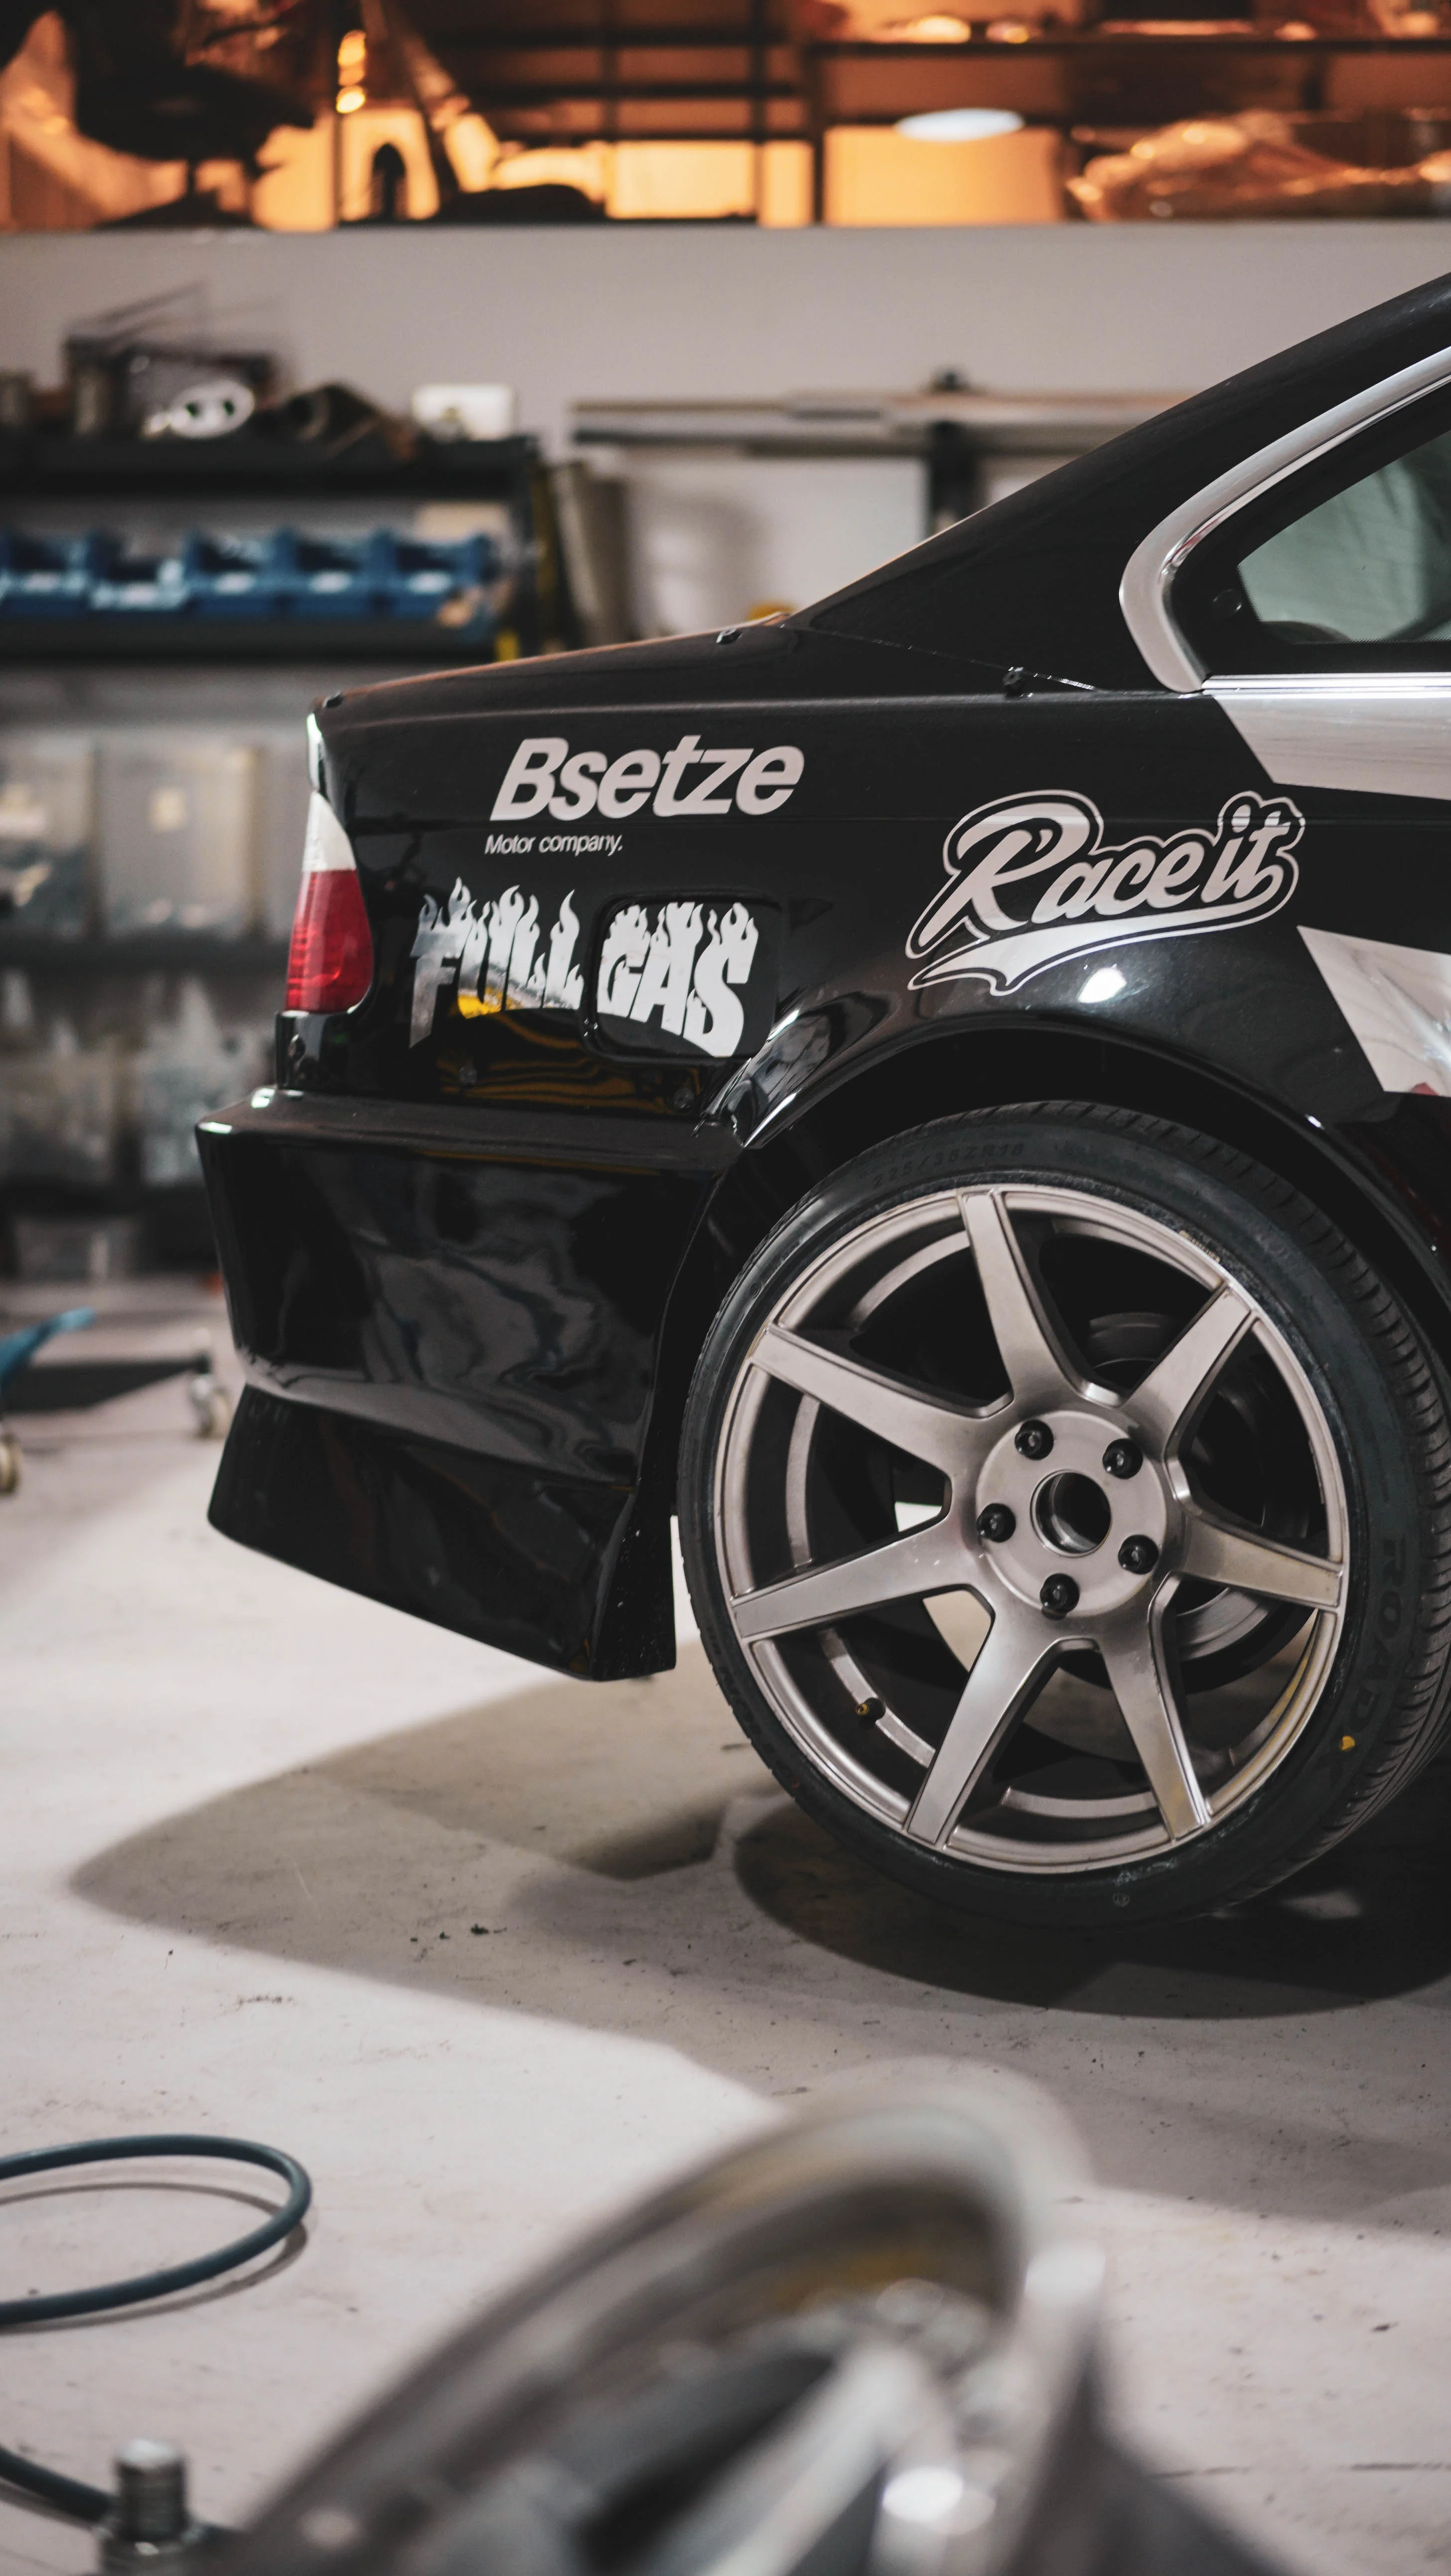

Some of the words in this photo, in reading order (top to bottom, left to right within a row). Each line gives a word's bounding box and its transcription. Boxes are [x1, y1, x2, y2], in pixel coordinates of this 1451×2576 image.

[490, 735, 804, 821] Bsetze
[485, 834, 536, 854] Motor
[539, 834, 623, 857] company.
[410, 877, 585, 1049] FULL
[597, 902, 759, 1057] GAS
